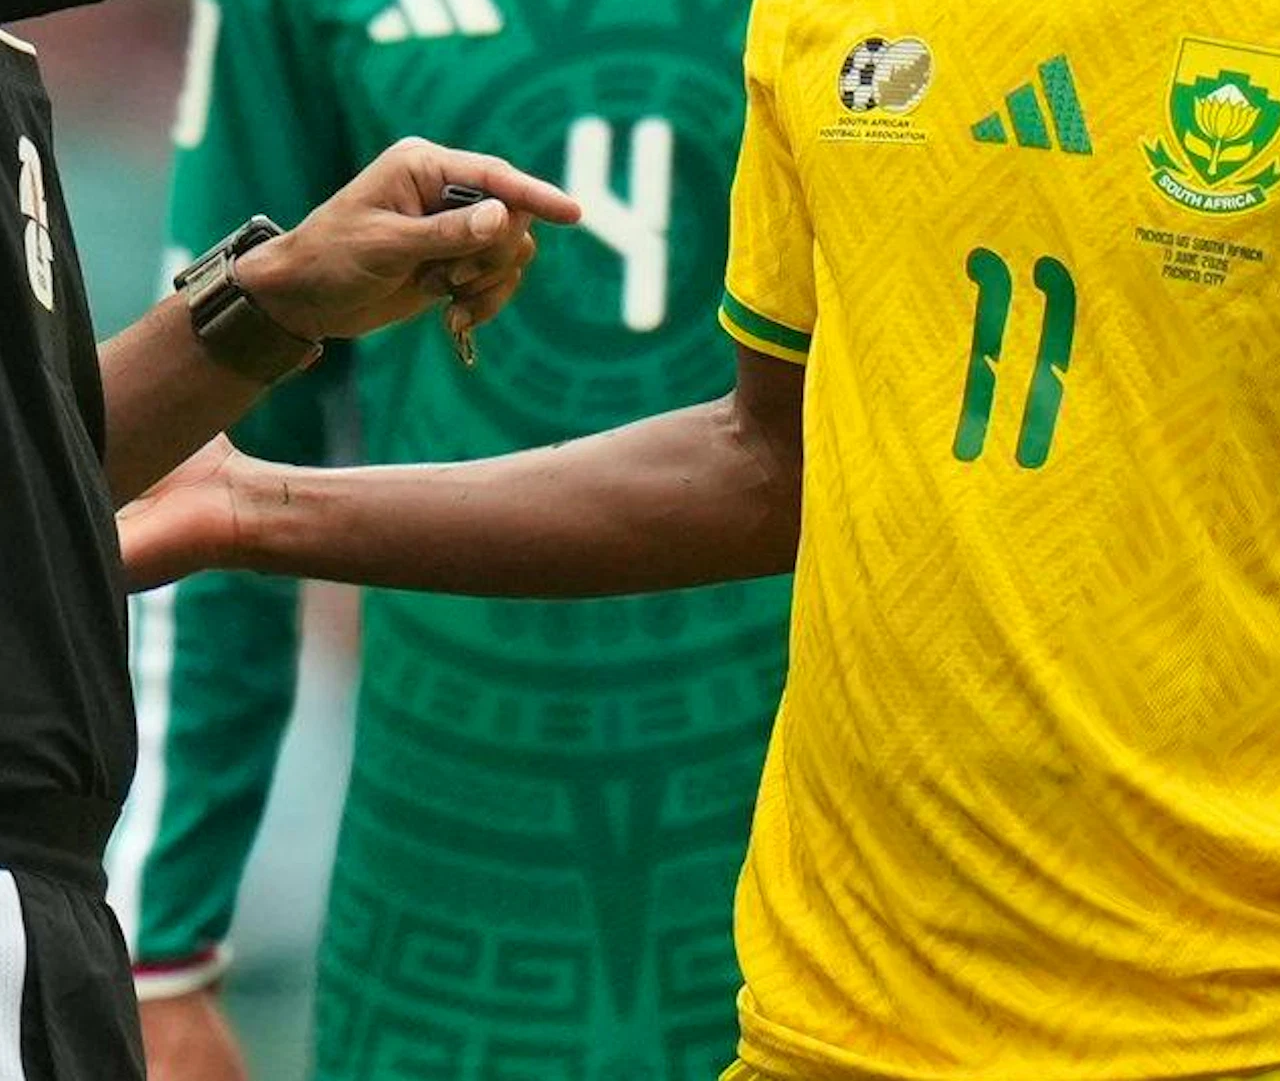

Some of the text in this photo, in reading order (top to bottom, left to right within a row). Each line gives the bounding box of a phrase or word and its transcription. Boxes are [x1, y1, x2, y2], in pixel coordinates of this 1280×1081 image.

[566, 115, 673, 331] 4
[1158, 174, 1257, 209] SOUTH AFRICA
[953, 246, 1076, 469] 11
